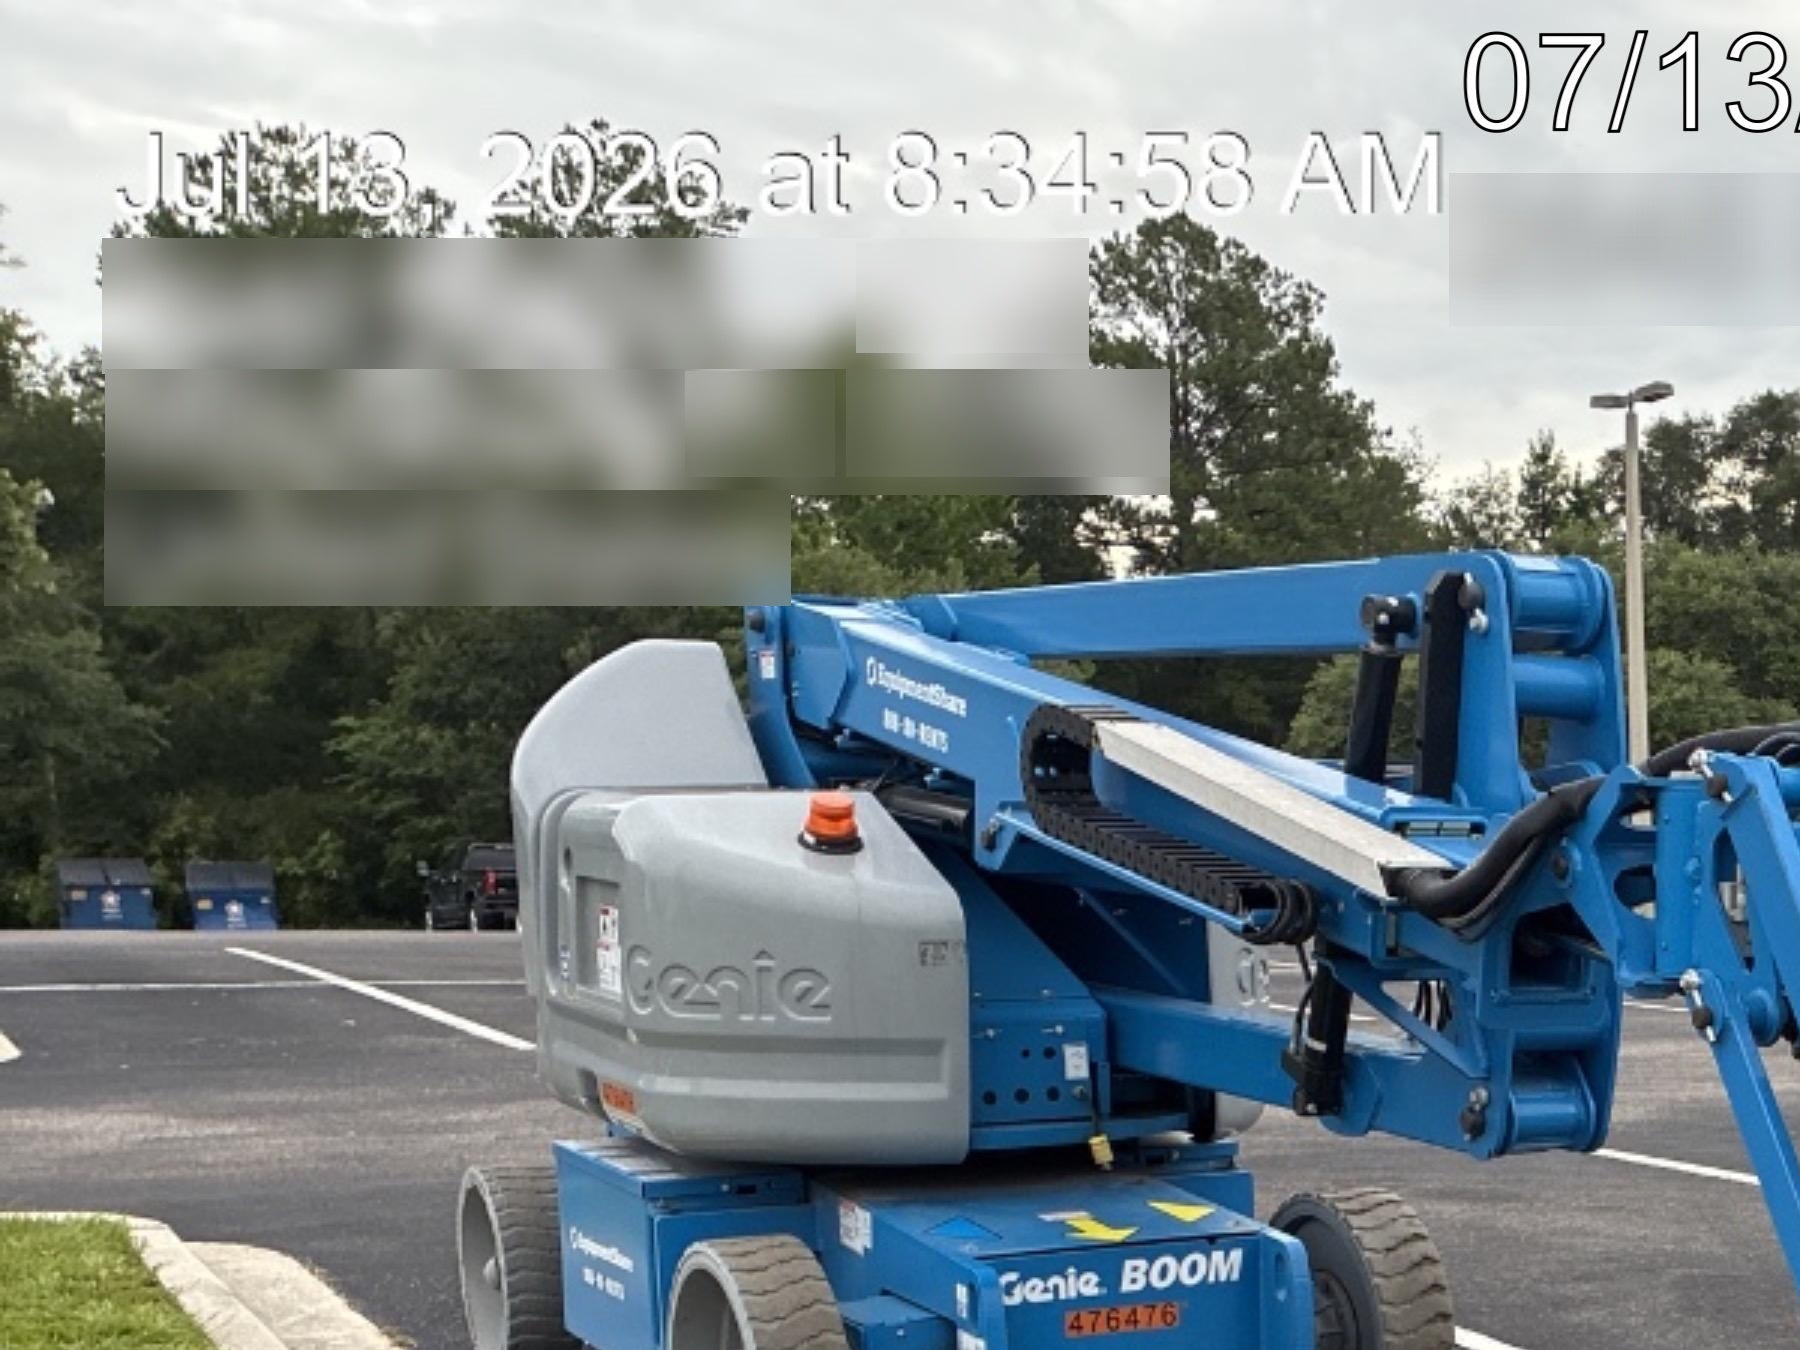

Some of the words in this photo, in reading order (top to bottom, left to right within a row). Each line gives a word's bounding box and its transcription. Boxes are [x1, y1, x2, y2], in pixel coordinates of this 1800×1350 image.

[626, 944, 833, 1021] Genie
[998, 1266, 1101, 1306] Genie
[1119, 1248, 1243, 1294] BOOM
[1067, 1303, 1177, 1334] 476476
